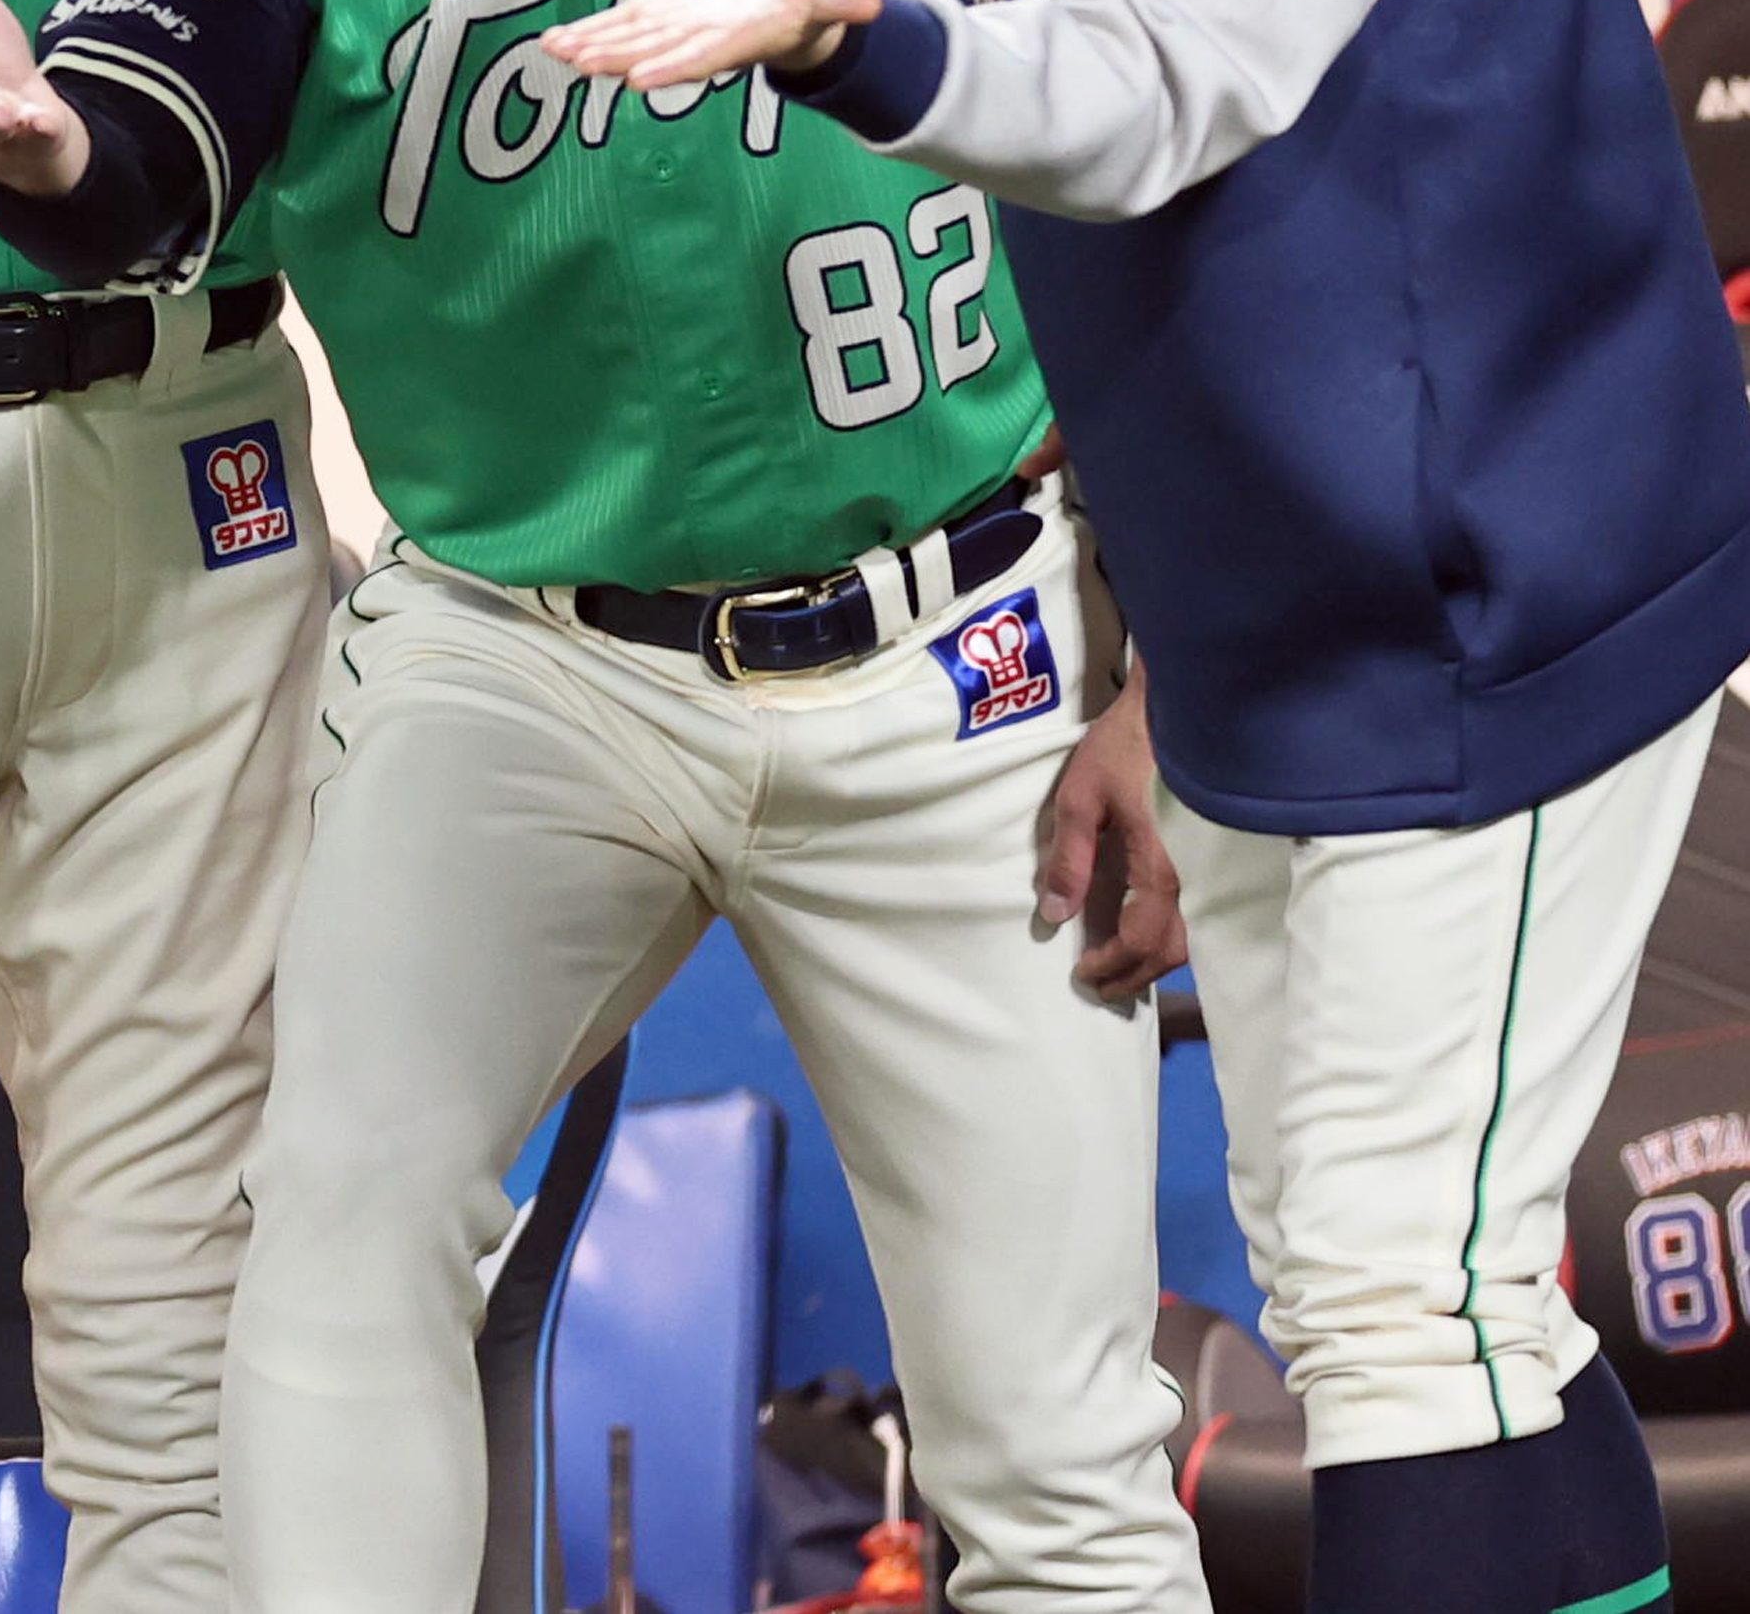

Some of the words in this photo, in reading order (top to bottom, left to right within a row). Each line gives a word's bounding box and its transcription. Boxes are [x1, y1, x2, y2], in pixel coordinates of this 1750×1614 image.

[783, 183, 1000, 432] 82
[215, 512, 286, 552] タフマン
[972, 677, 1048, 725] タフマン
